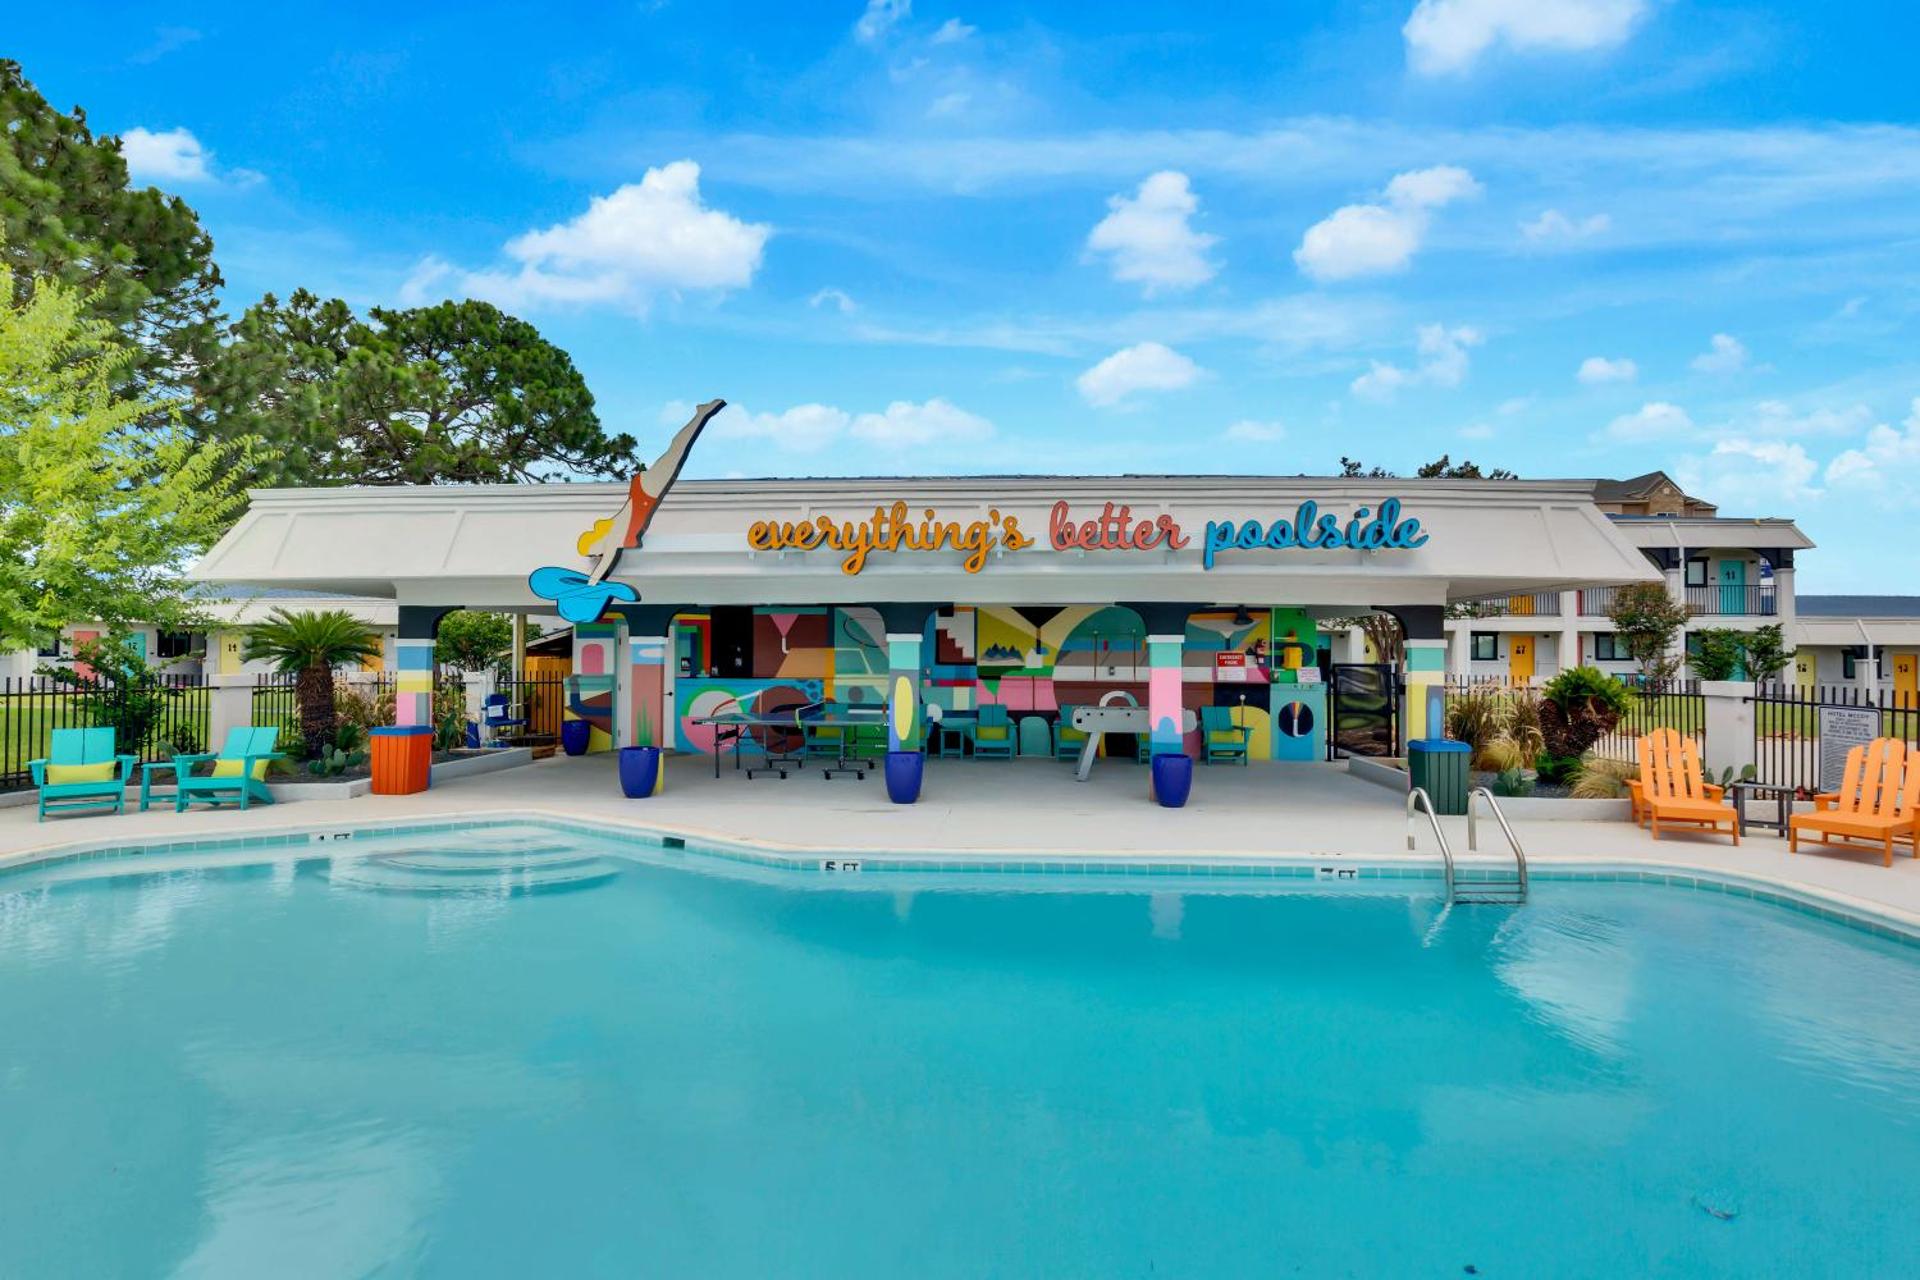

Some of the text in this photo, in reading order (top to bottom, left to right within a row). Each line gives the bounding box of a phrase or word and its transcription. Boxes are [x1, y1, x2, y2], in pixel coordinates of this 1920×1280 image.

[747, 497, 1429, 575] everything's better poolside
